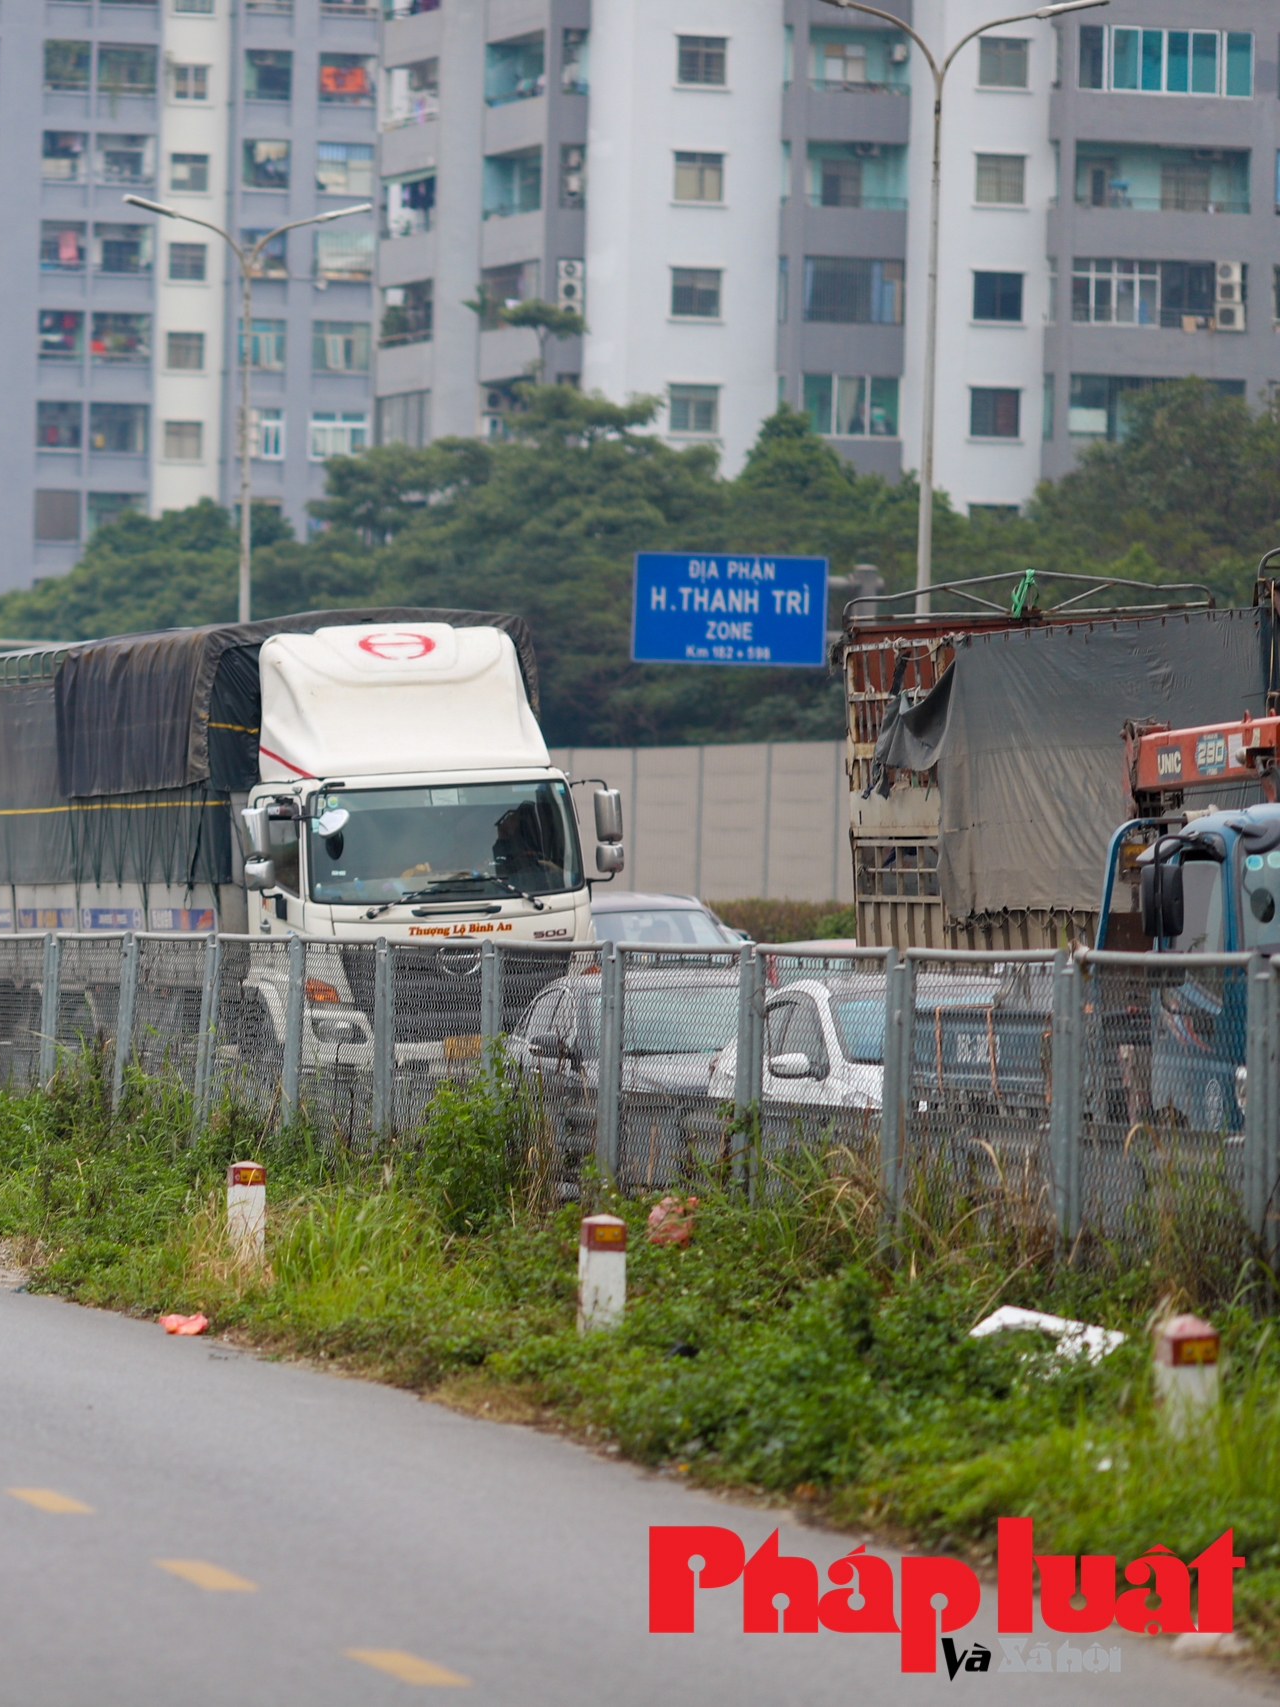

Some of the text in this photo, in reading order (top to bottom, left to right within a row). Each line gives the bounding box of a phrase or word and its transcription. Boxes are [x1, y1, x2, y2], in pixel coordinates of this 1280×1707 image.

[688, 558, 776, 585] ĐỊA PHẬN
[651, 583, 810, 616] H.THANH TRÌ
[705, 621, 753, 641] ZONE
[686, 645, 709, 659] Km
[1157, 750, 1182, 776] UNIC
[408, 921, 513, 937] Thượng Lộ Bình An
[533, 928, 568, 939] 500
